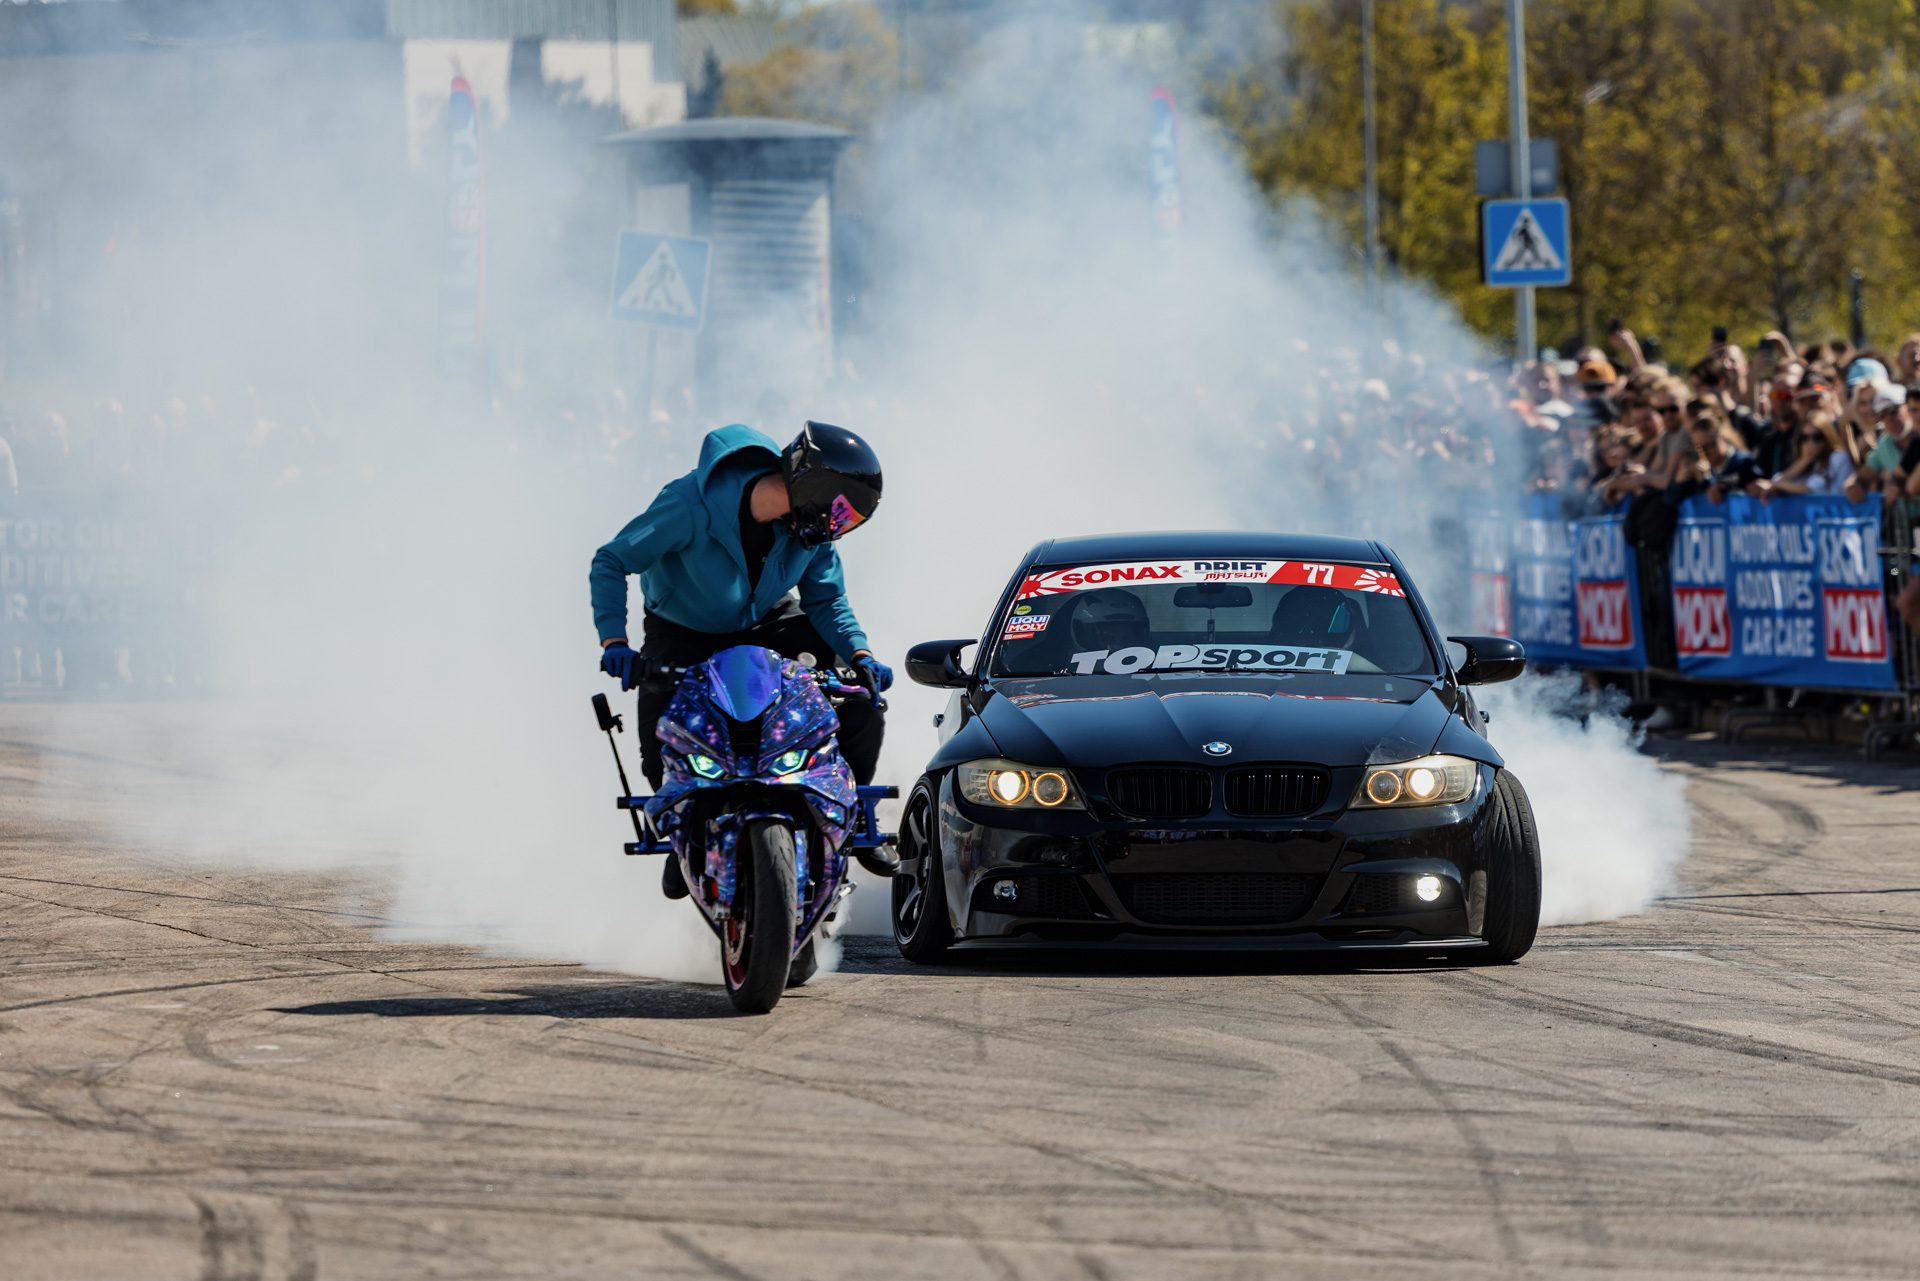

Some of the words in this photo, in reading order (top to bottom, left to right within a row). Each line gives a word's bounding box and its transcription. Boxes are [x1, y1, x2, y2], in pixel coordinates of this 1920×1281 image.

[1061, 566, 1183, 587] SONAX
[1194, 561, 1267, 571] DRIFT
[1303, 564, 1334, 585] 77
[1008, 623, 1046, 632] MOLY
[1011, 616, 1047, 624] LIQUI
[1826, 594, 1882, 653] MOLY
[1742, 617, 1773, 655] CAR
[1774, 618, 1815, 657] CARE
